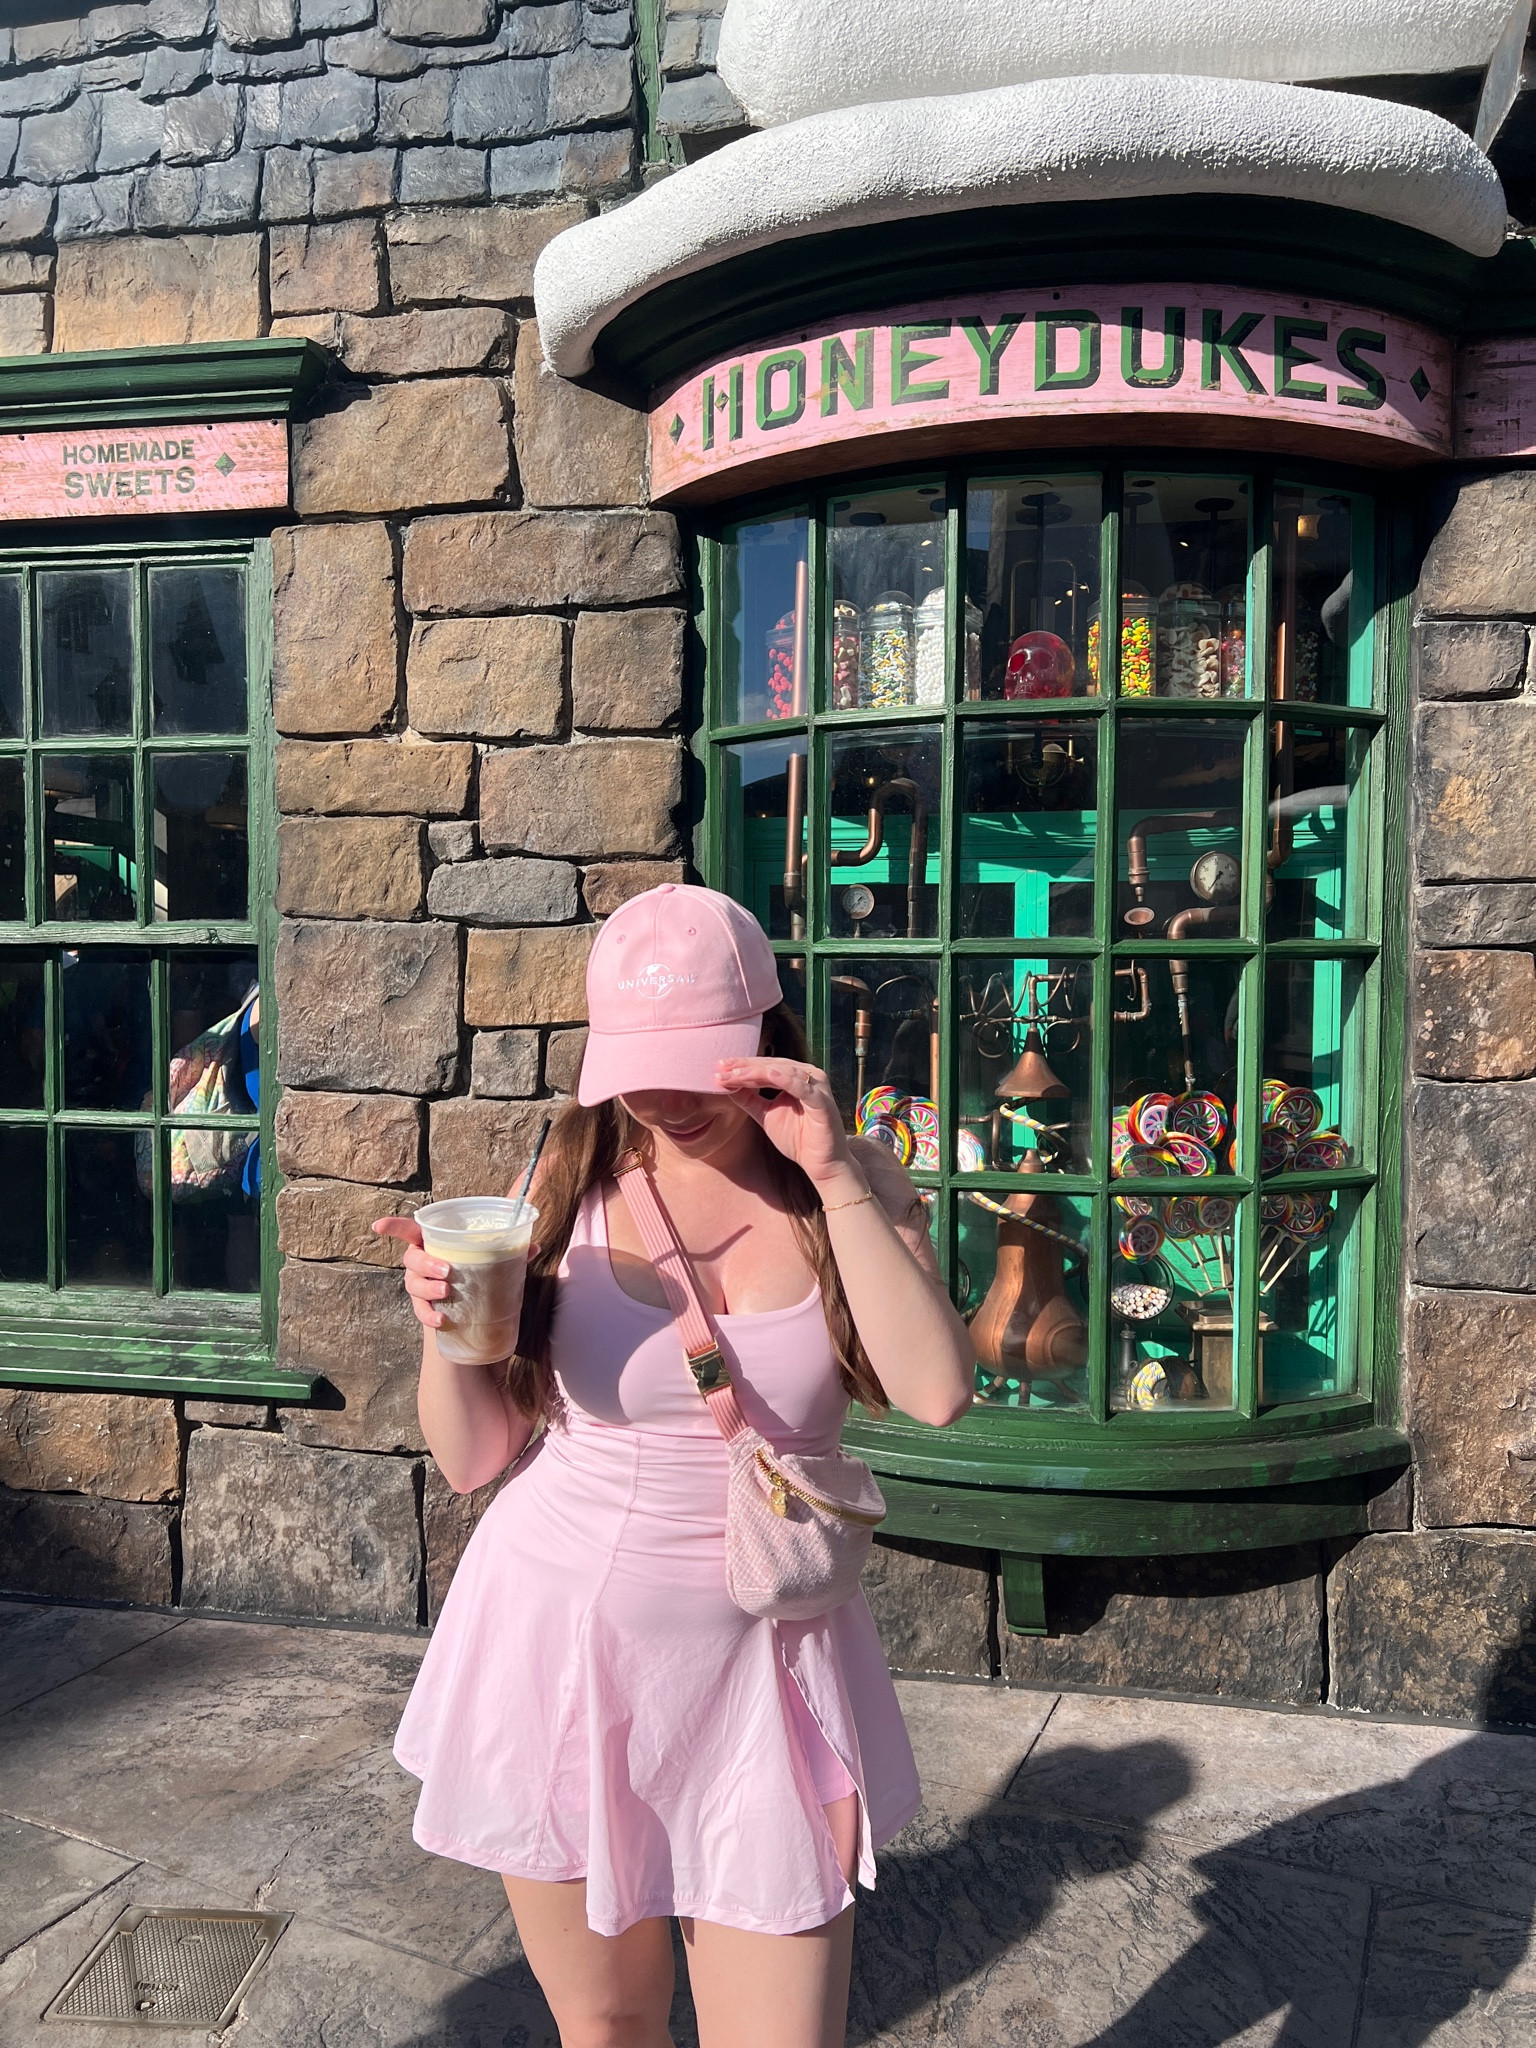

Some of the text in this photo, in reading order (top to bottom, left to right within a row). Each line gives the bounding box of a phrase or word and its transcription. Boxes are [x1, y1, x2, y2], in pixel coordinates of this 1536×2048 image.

[702, 305, 1388, 452] HONEYDUKES
[62, 438, 196, 466] HOMEMADE
[63, 465, 196, 500] SWEETS
[617, 974, 695, 991] UNIVERSAL
